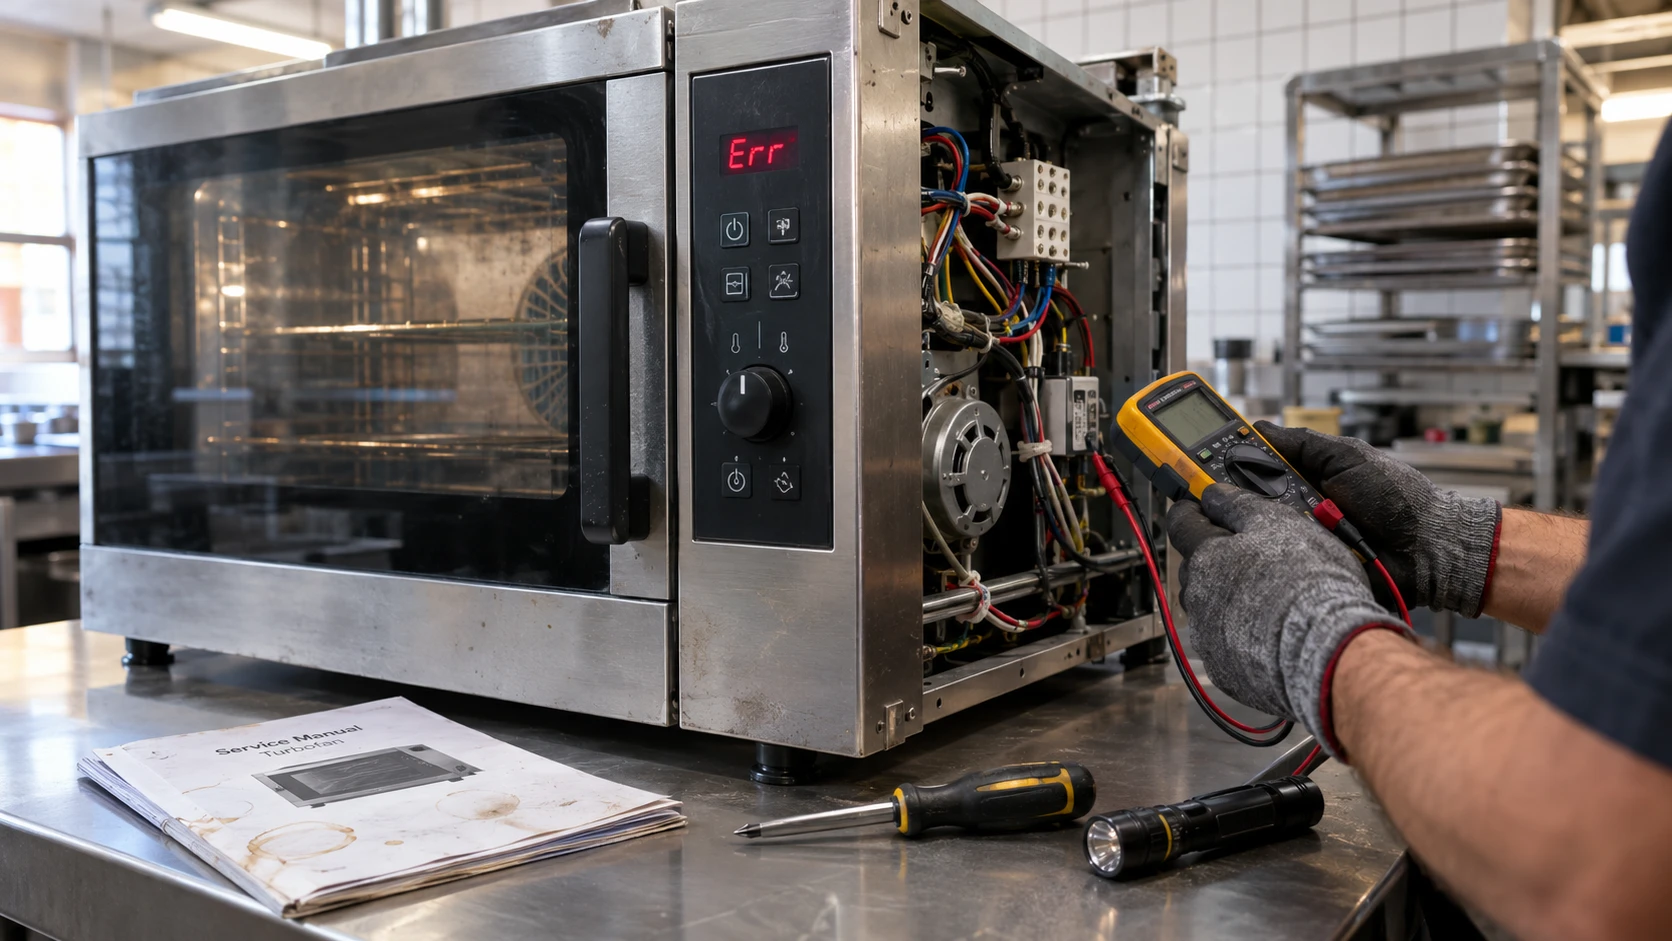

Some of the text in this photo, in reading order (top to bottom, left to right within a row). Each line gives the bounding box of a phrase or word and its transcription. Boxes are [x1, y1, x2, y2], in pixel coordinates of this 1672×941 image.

[729, 138, 784, 169] Err
[215, 725, 363, 756] Service Manual
[259, 738, 345, 757] Turbofan
